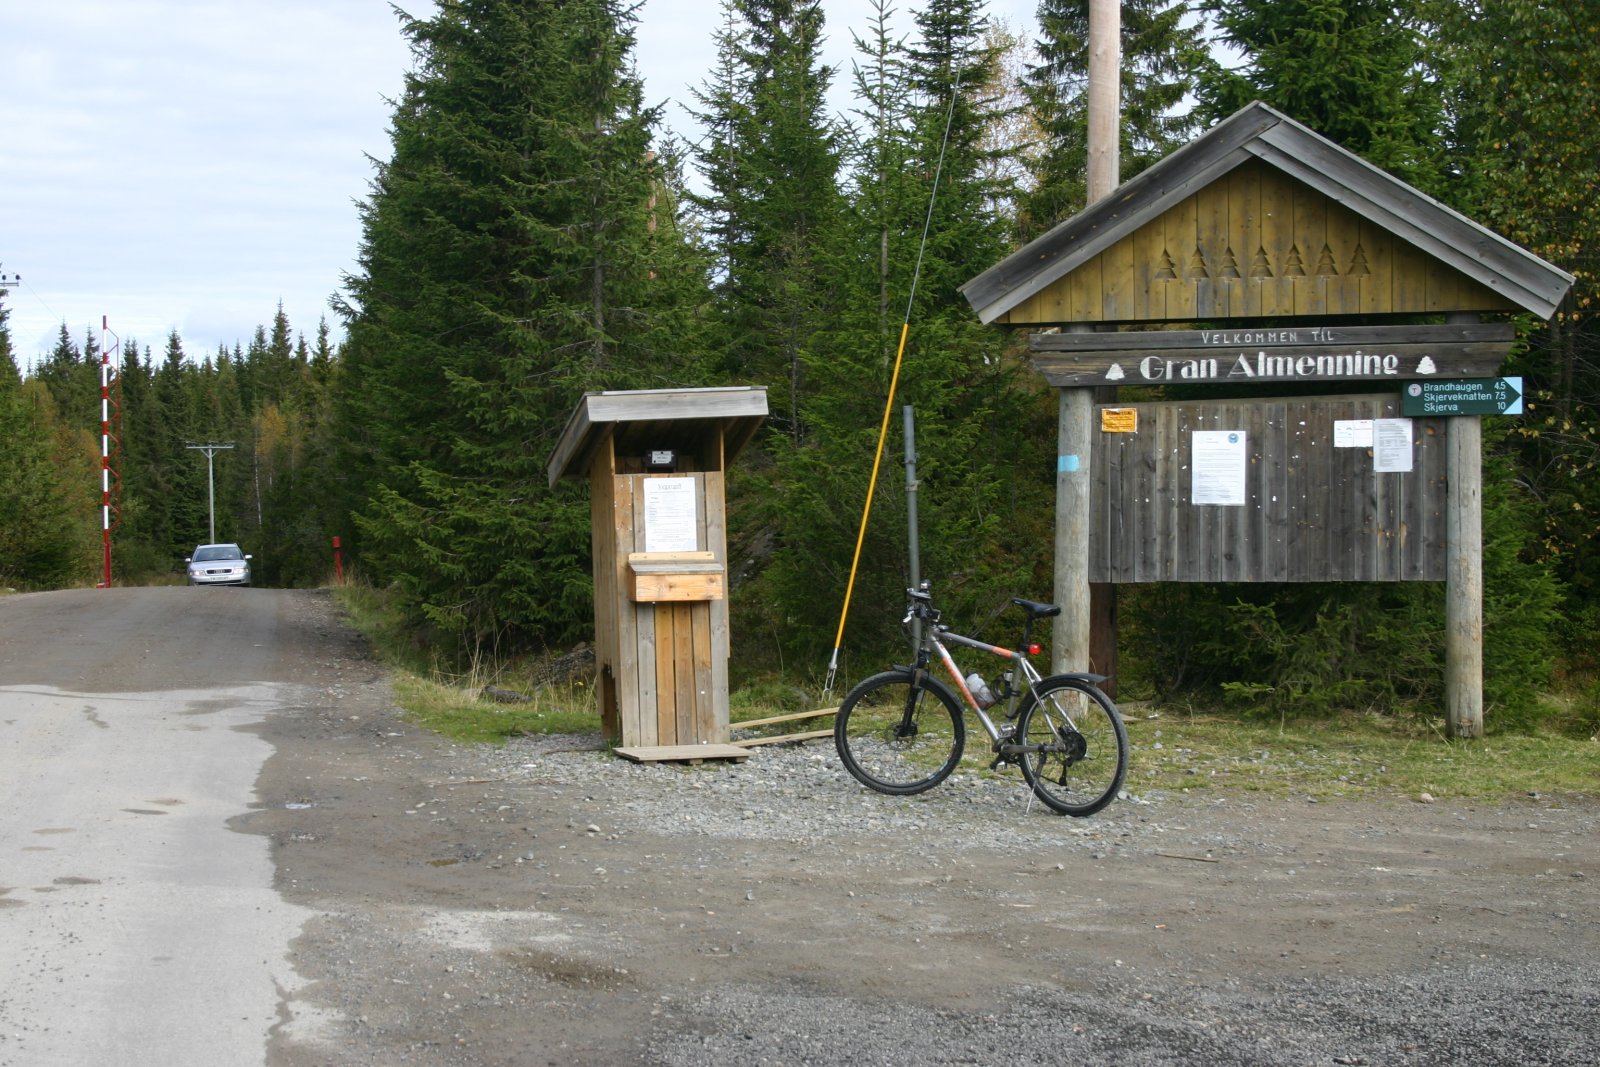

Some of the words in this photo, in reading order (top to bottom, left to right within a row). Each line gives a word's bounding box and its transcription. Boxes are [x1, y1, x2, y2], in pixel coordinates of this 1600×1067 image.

[1201, 331, 1297, 344] VELKOMMEN
[1311, 330, 1335, 342] TIL
[1140, 355, 1218, 380] Gran
[1226, 350, 1399, 378] Almenning
[1423, 382, 1483, 392] Brandhaugen
[1423, 392, 1492, 402] Skjerveknatten
[1423, 402, 1458, 412] Skjerva
[1497, 402, 1506, 410] 10
